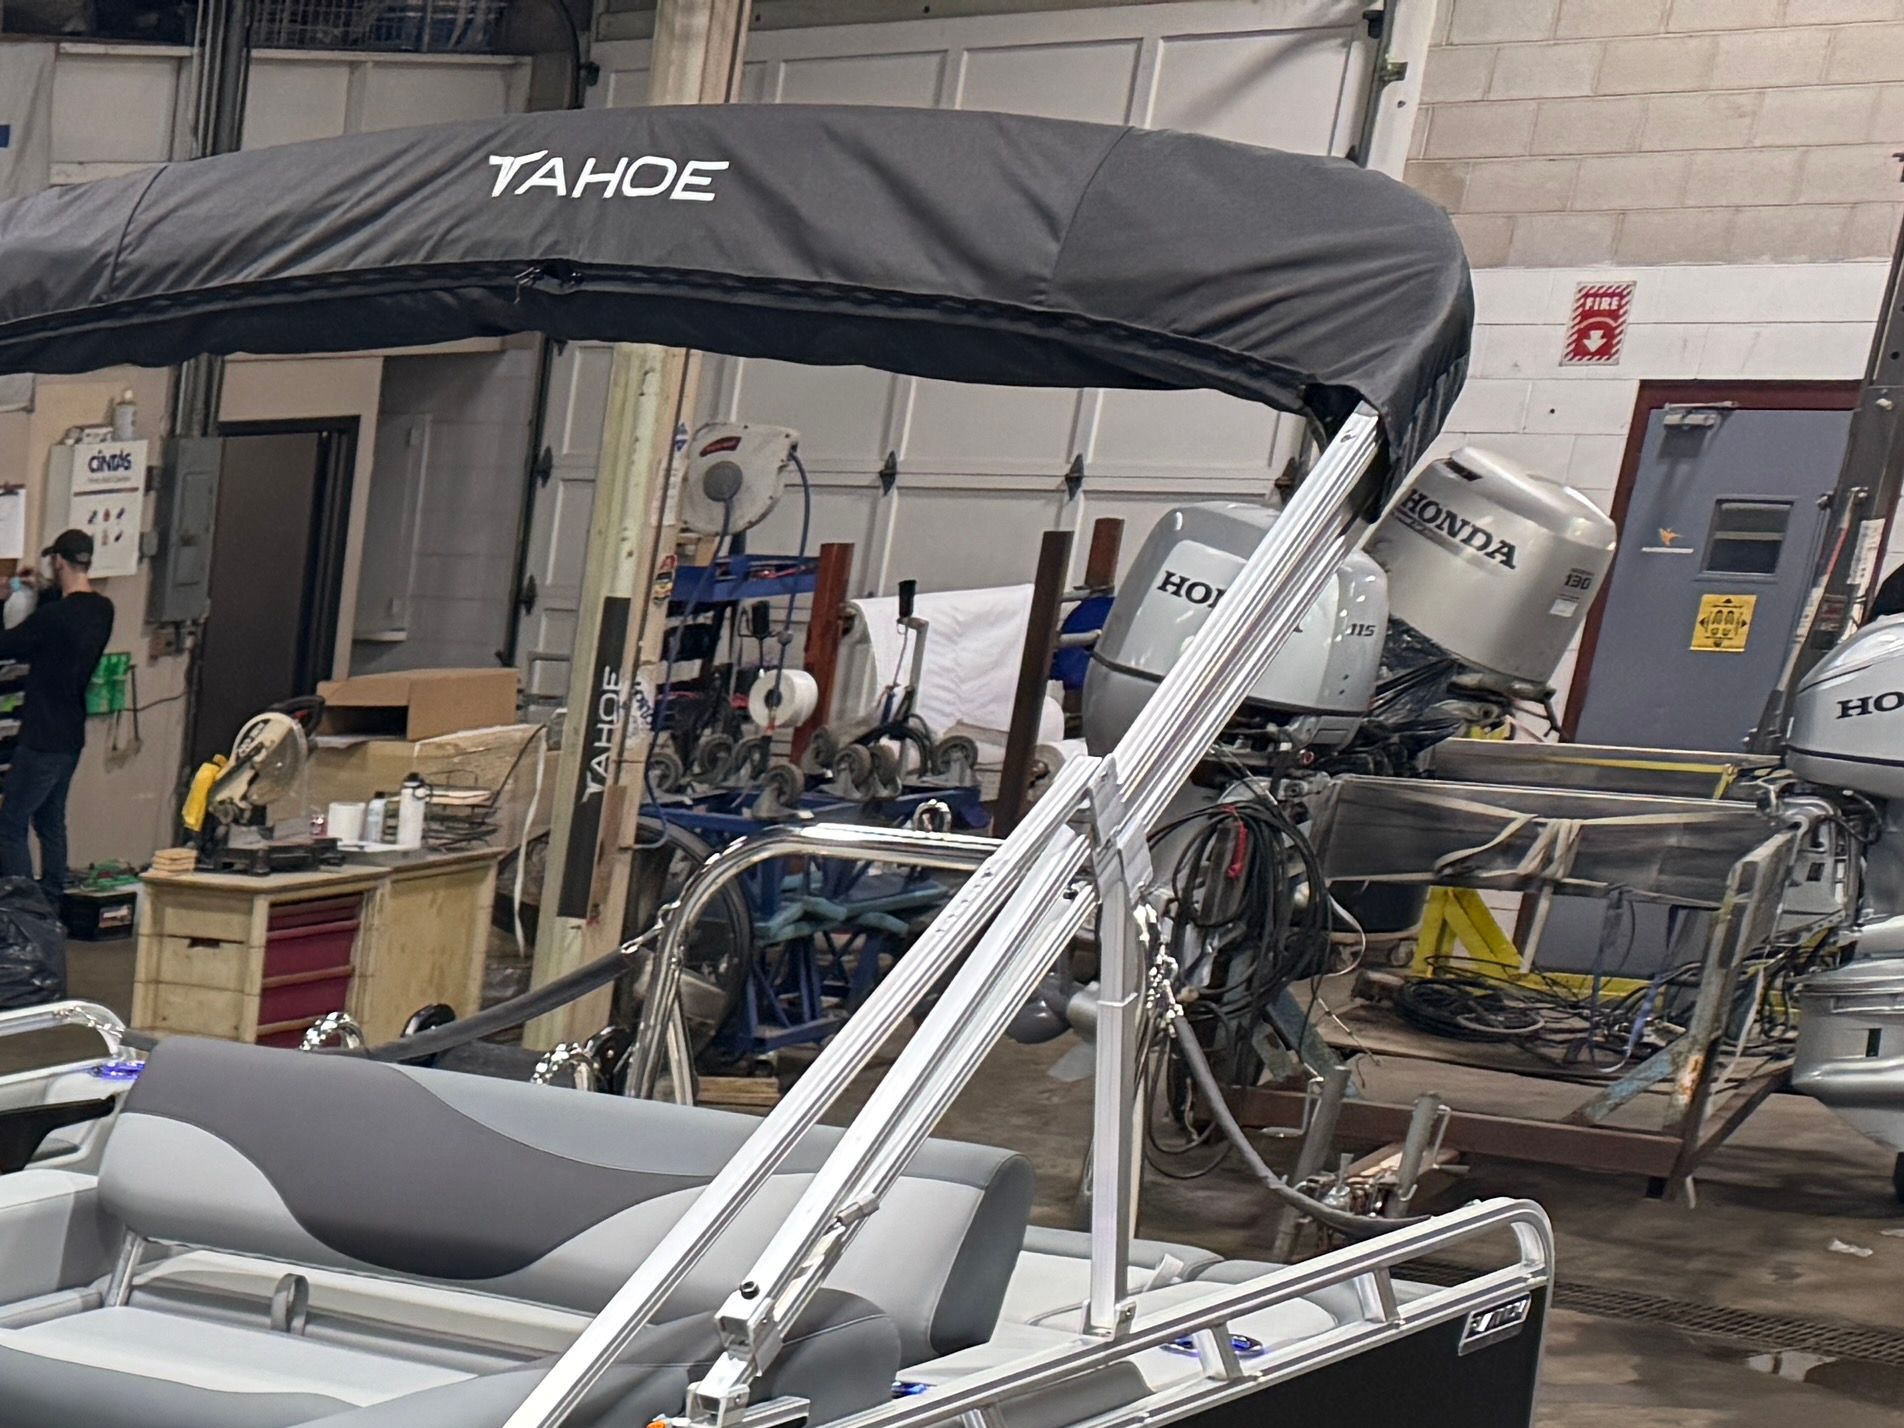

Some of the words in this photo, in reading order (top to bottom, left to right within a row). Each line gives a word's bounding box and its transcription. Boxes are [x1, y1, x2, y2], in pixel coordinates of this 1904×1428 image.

[488, 149, 730, 201] TAHOE
[1584, 296, 1621, 310] FIRE
[1400, 488, 1517, 570] HONDA
[1564, 573, 1592, 590] 130
[1346, 623, 1377, 637] 115
[1836, 691, 1904, 719] HO
[582, 666, 623, 803] TAHOE
